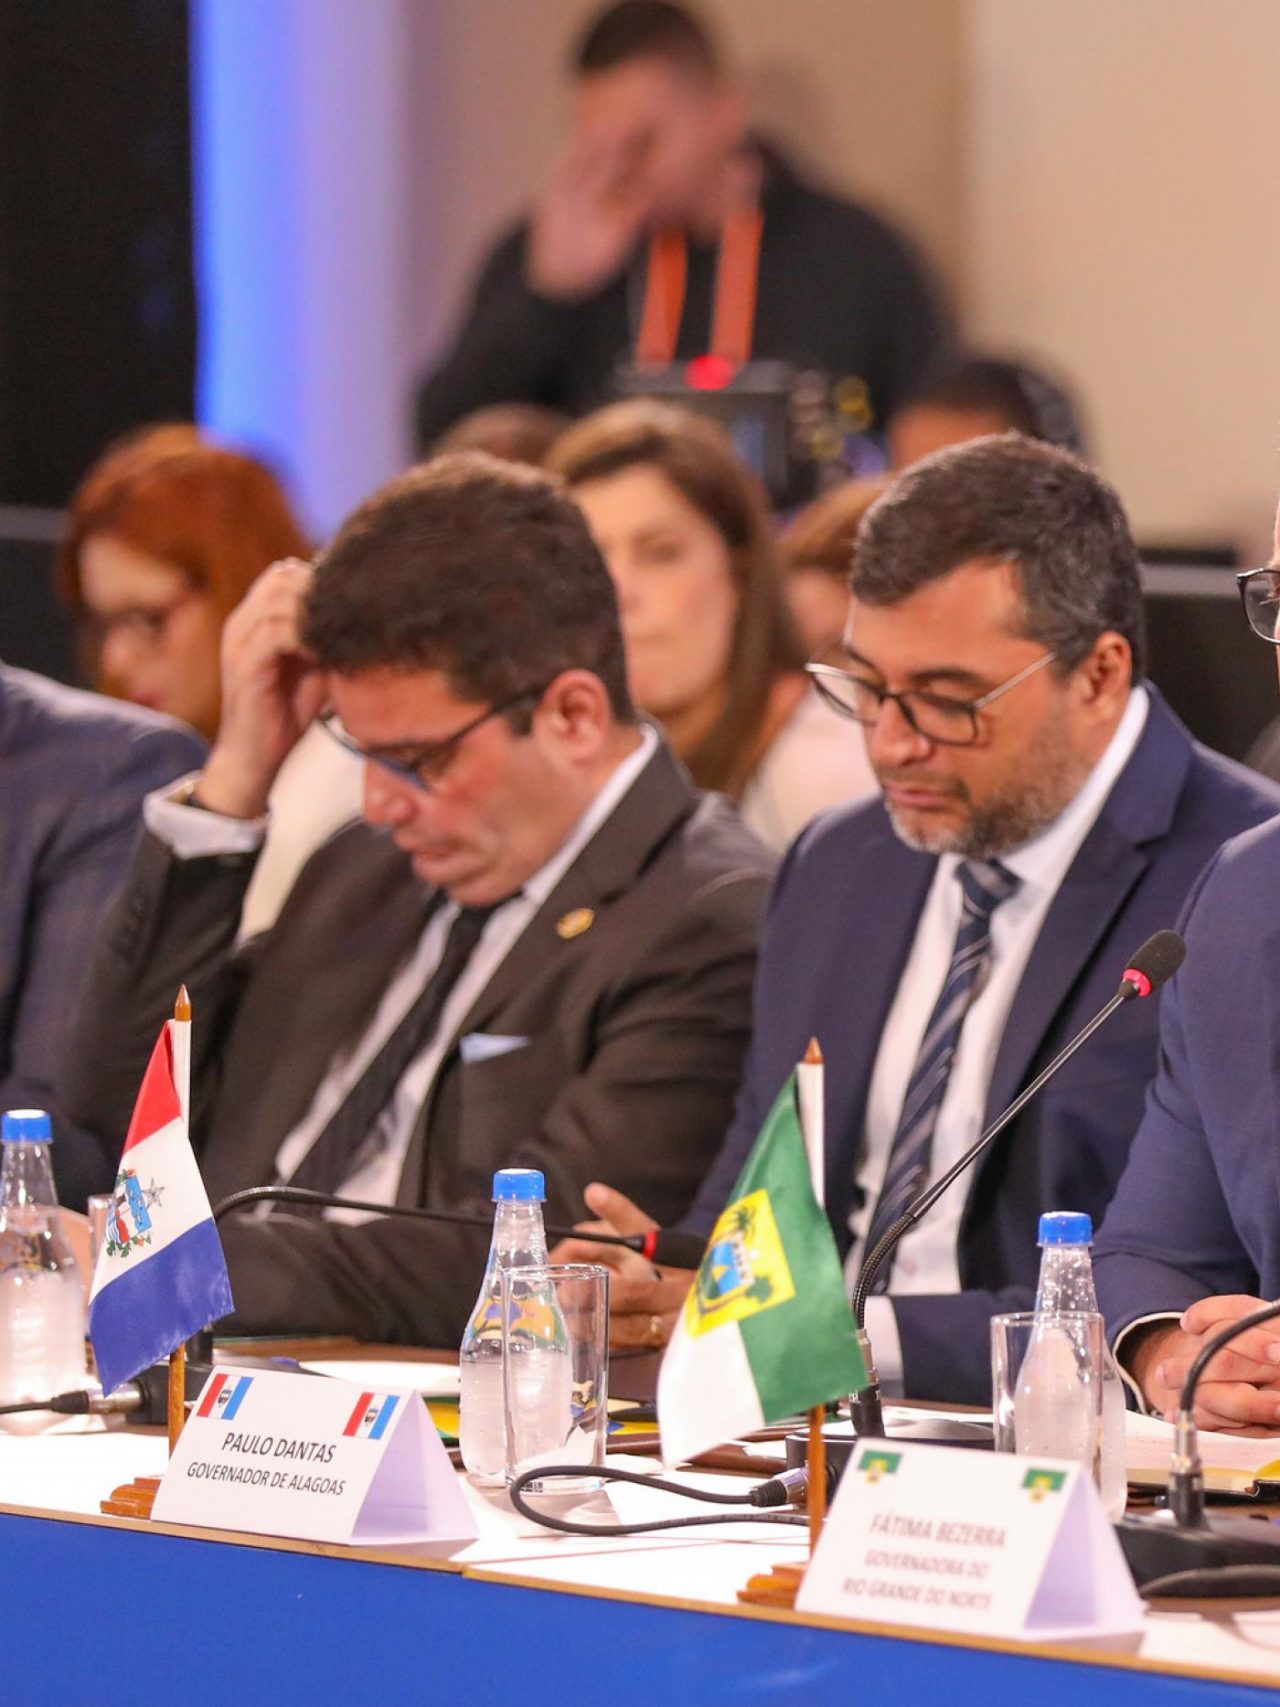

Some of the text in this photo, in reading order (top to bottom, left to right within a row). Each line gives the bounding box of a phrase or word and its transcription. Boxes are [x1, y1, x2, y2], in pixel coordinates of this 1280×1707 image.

[221, 1432, 336, 1463] PAULO DANTAS
[187, 1462, 346, 1496] GOVERNADOR DE ALAGOAS
[869, 1510, 1007, 1548] FÁTIMA BEZERRA
[864, 1549, 990, 1580] GOVERNADORA DO
[842, 1577, 993, 1611] RIO GRANDE DO NORTE
